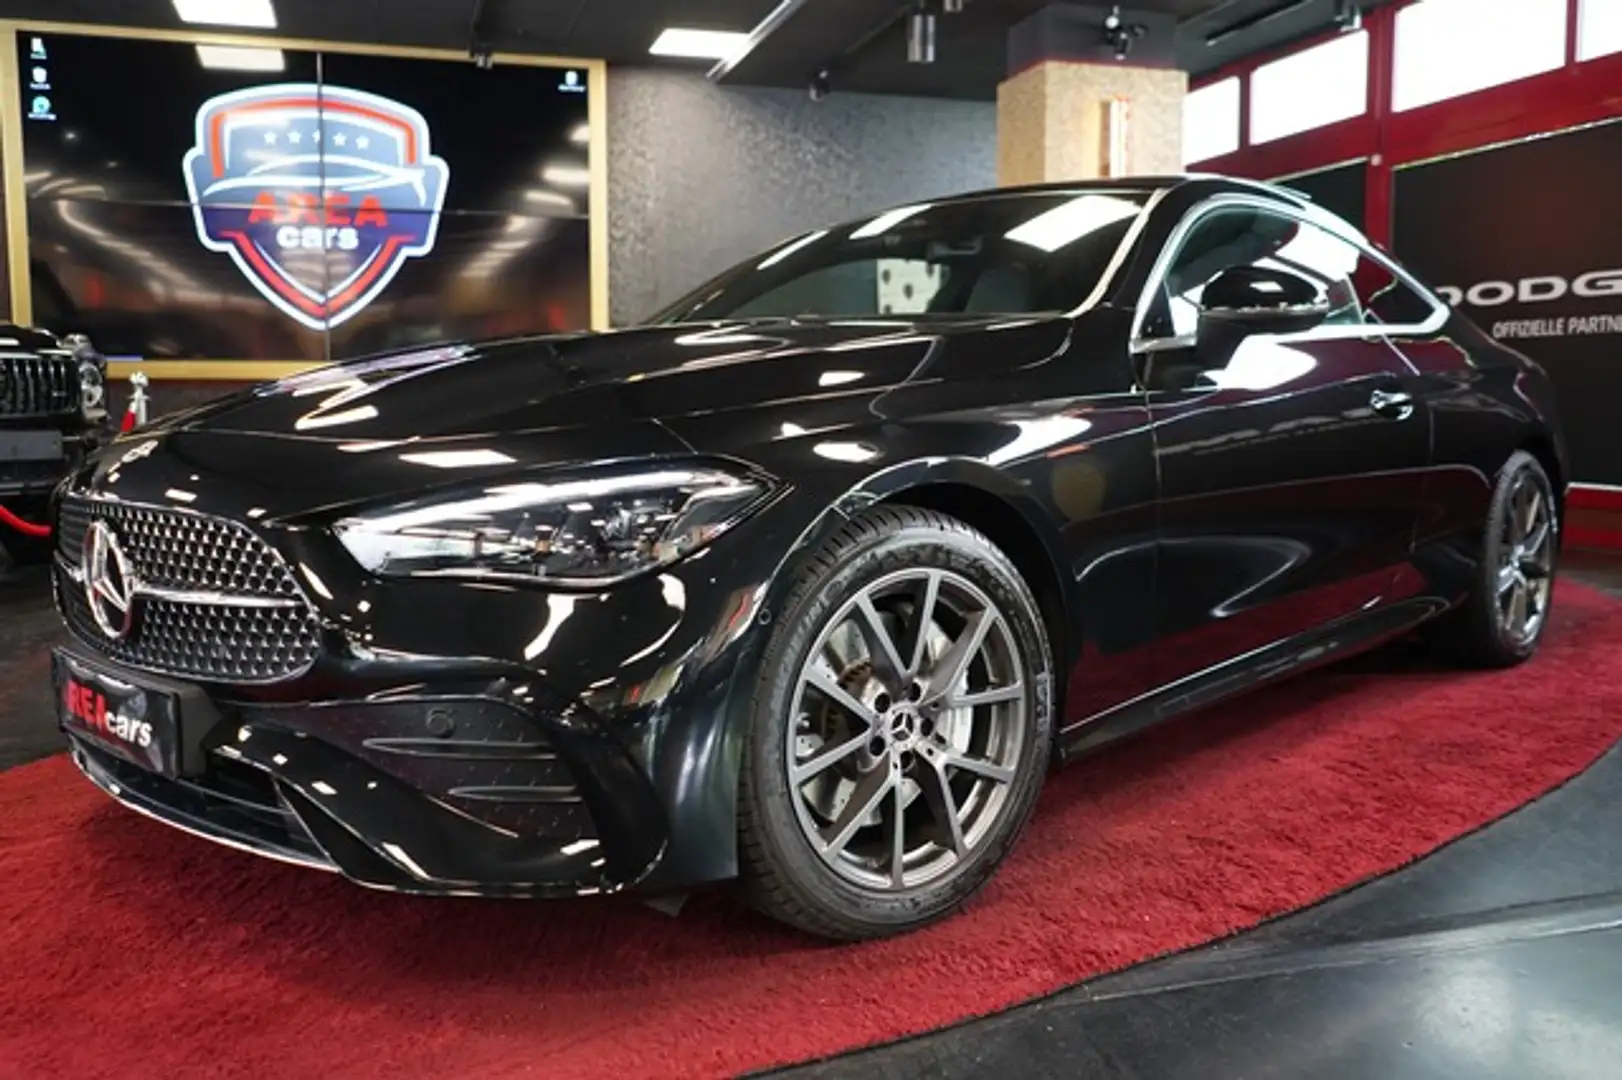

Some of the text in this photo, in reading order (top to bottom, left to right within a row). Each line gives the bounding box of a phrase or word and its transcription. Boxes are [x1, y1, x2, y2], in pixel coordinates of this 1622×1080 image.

[248, 190, 388, 227] AREA
[276, 225, 359, 250] cars
[1492, 316, 1565, 338] OFFIZIELLE
